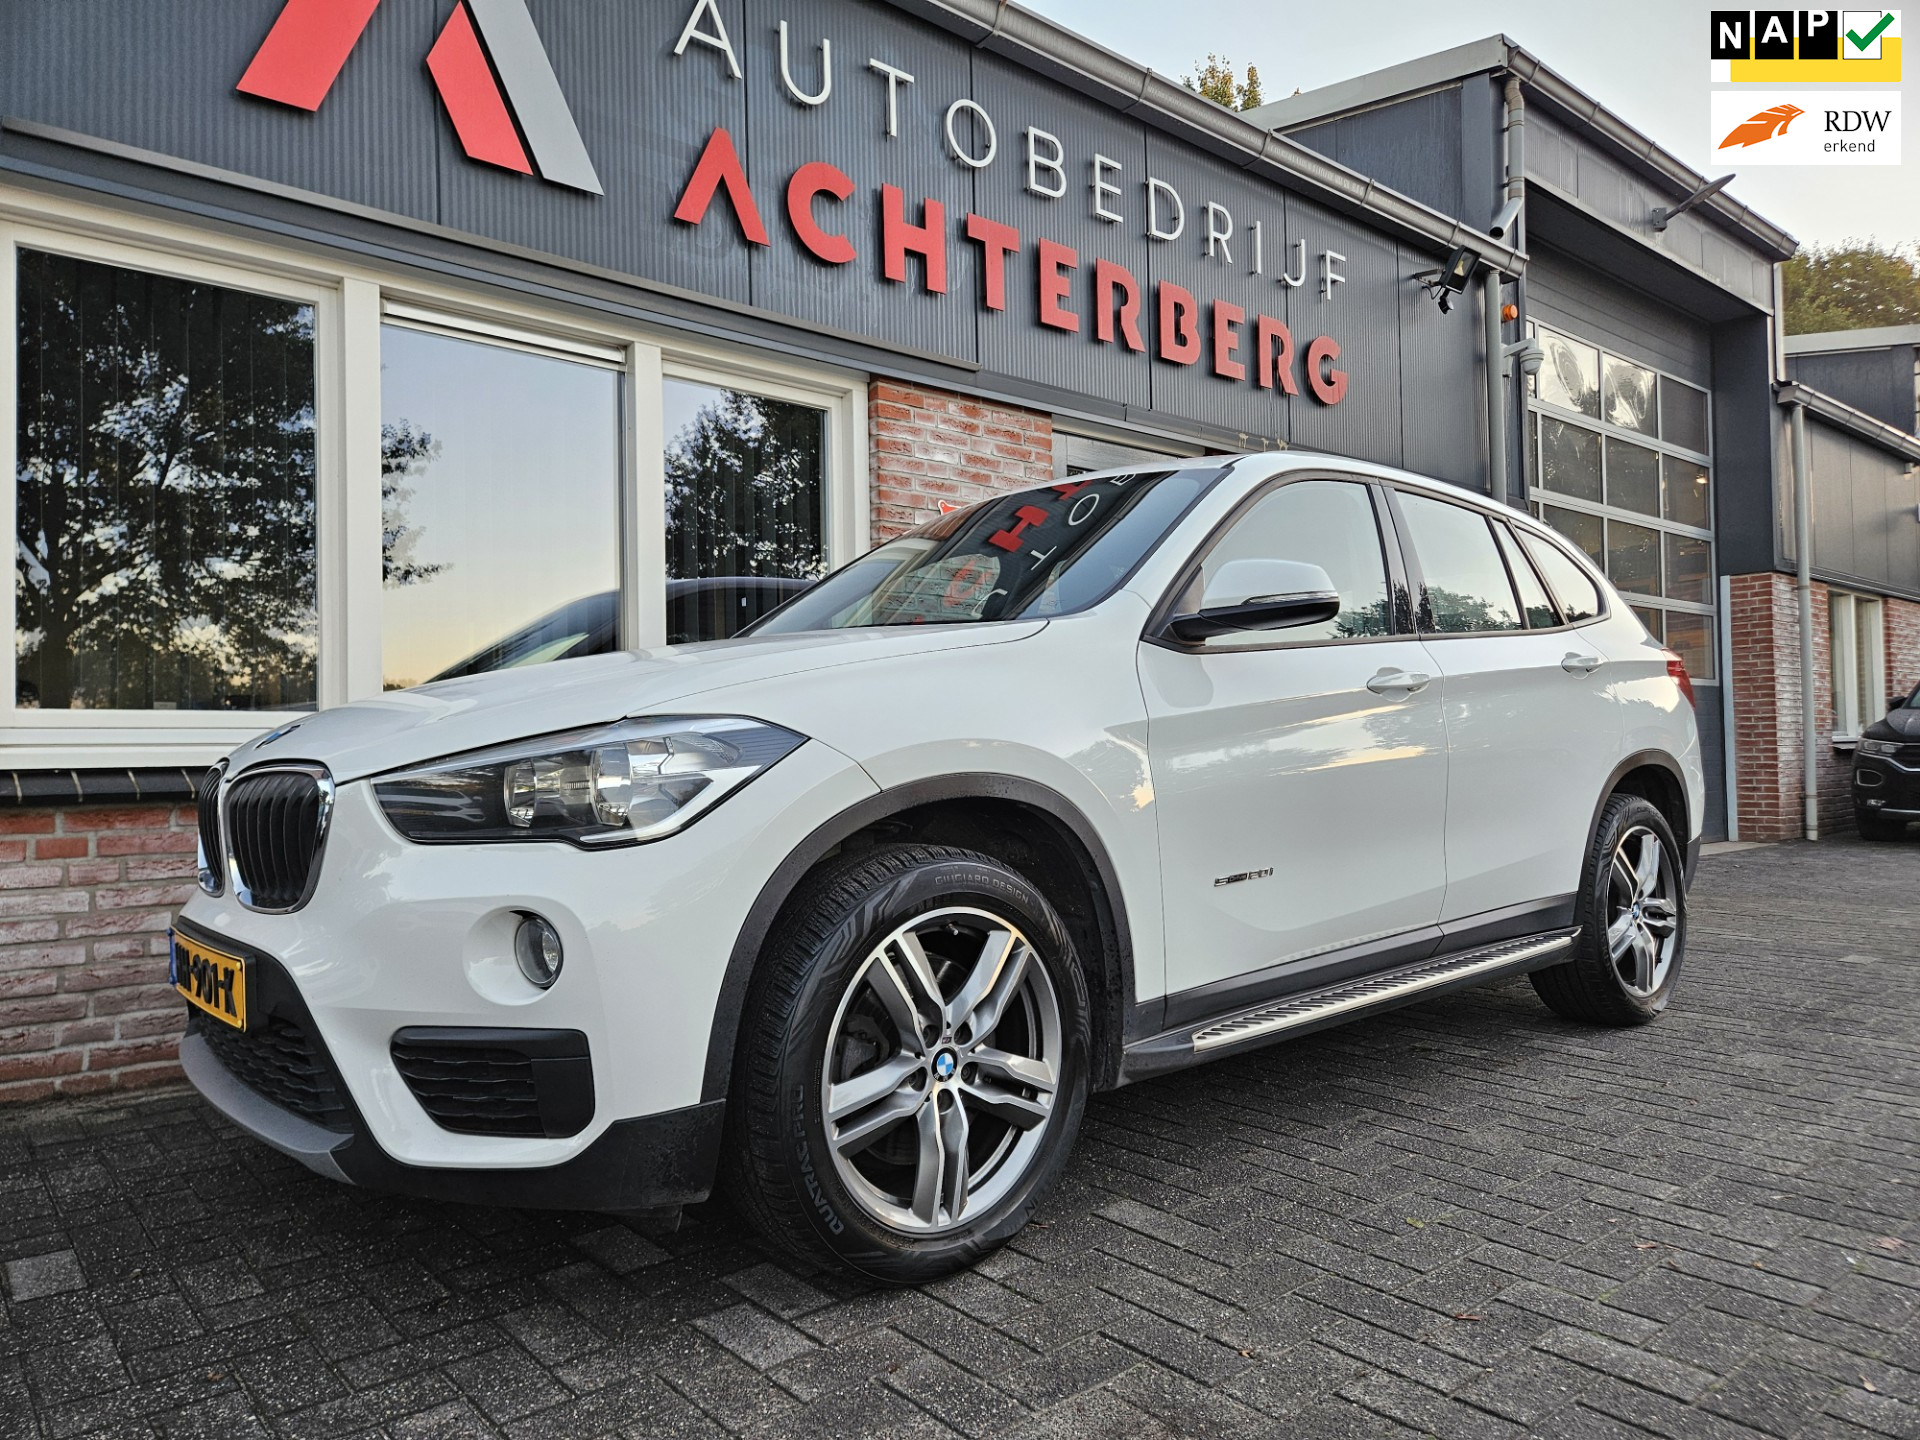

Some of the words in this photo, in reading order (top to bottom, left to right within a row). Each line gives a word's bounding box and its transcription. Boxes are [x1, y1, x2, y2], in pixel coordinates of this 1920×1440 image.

[674, 0, 1347, 300] AUTOBEDRIJF
[674, 127, 1348, 405] ACHTERBERG
[992, 878, 1030, 904] DESIGN
